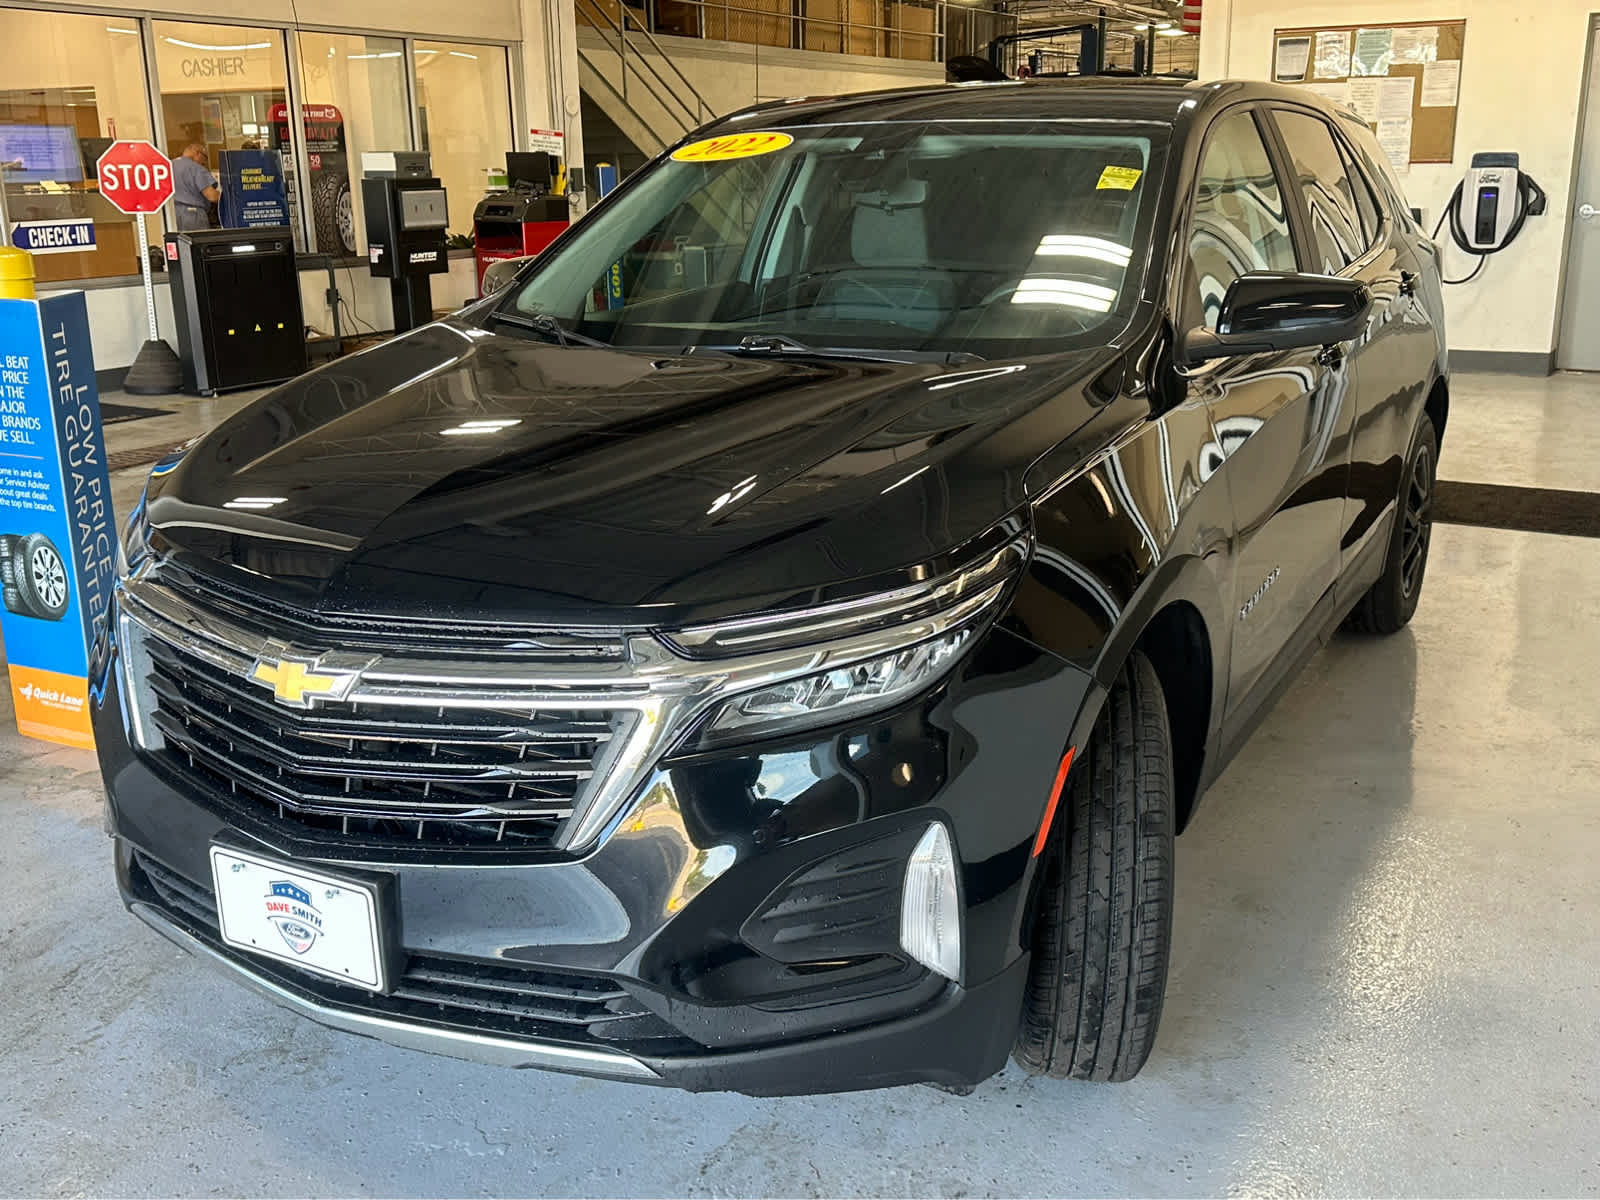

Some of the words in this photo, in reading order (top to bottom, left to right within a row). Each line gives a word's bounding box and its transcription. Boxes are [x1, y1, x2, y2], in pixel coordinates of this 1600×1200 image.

[181, 57, 246, 79] CASHIER
[102, 164, 168, 191] STOP
[1479, 174, 1502, 184] Ford
[28, 225, 90, 248] CHECK-IN
[5, 355, 29, 369] BEAT
[52, 322, 74, 404] TIRE
[2, 370, 30, 384] PRICE
[5, 385, 25, 399] THE
[2, 415, 41, 430] BRANDS
[10, 430, 35, 444] SELL.
[20, 469, 32, 478] and
[76, 385, 98, 465] LOW
[88, 477, 112, 576] PRICE
[33, 687, 59, 702] Quick
[60, 691, 84, 706] Lane
[266, 902, 290, 913] DAVE
[292, 906, 322, 927] SMITH
